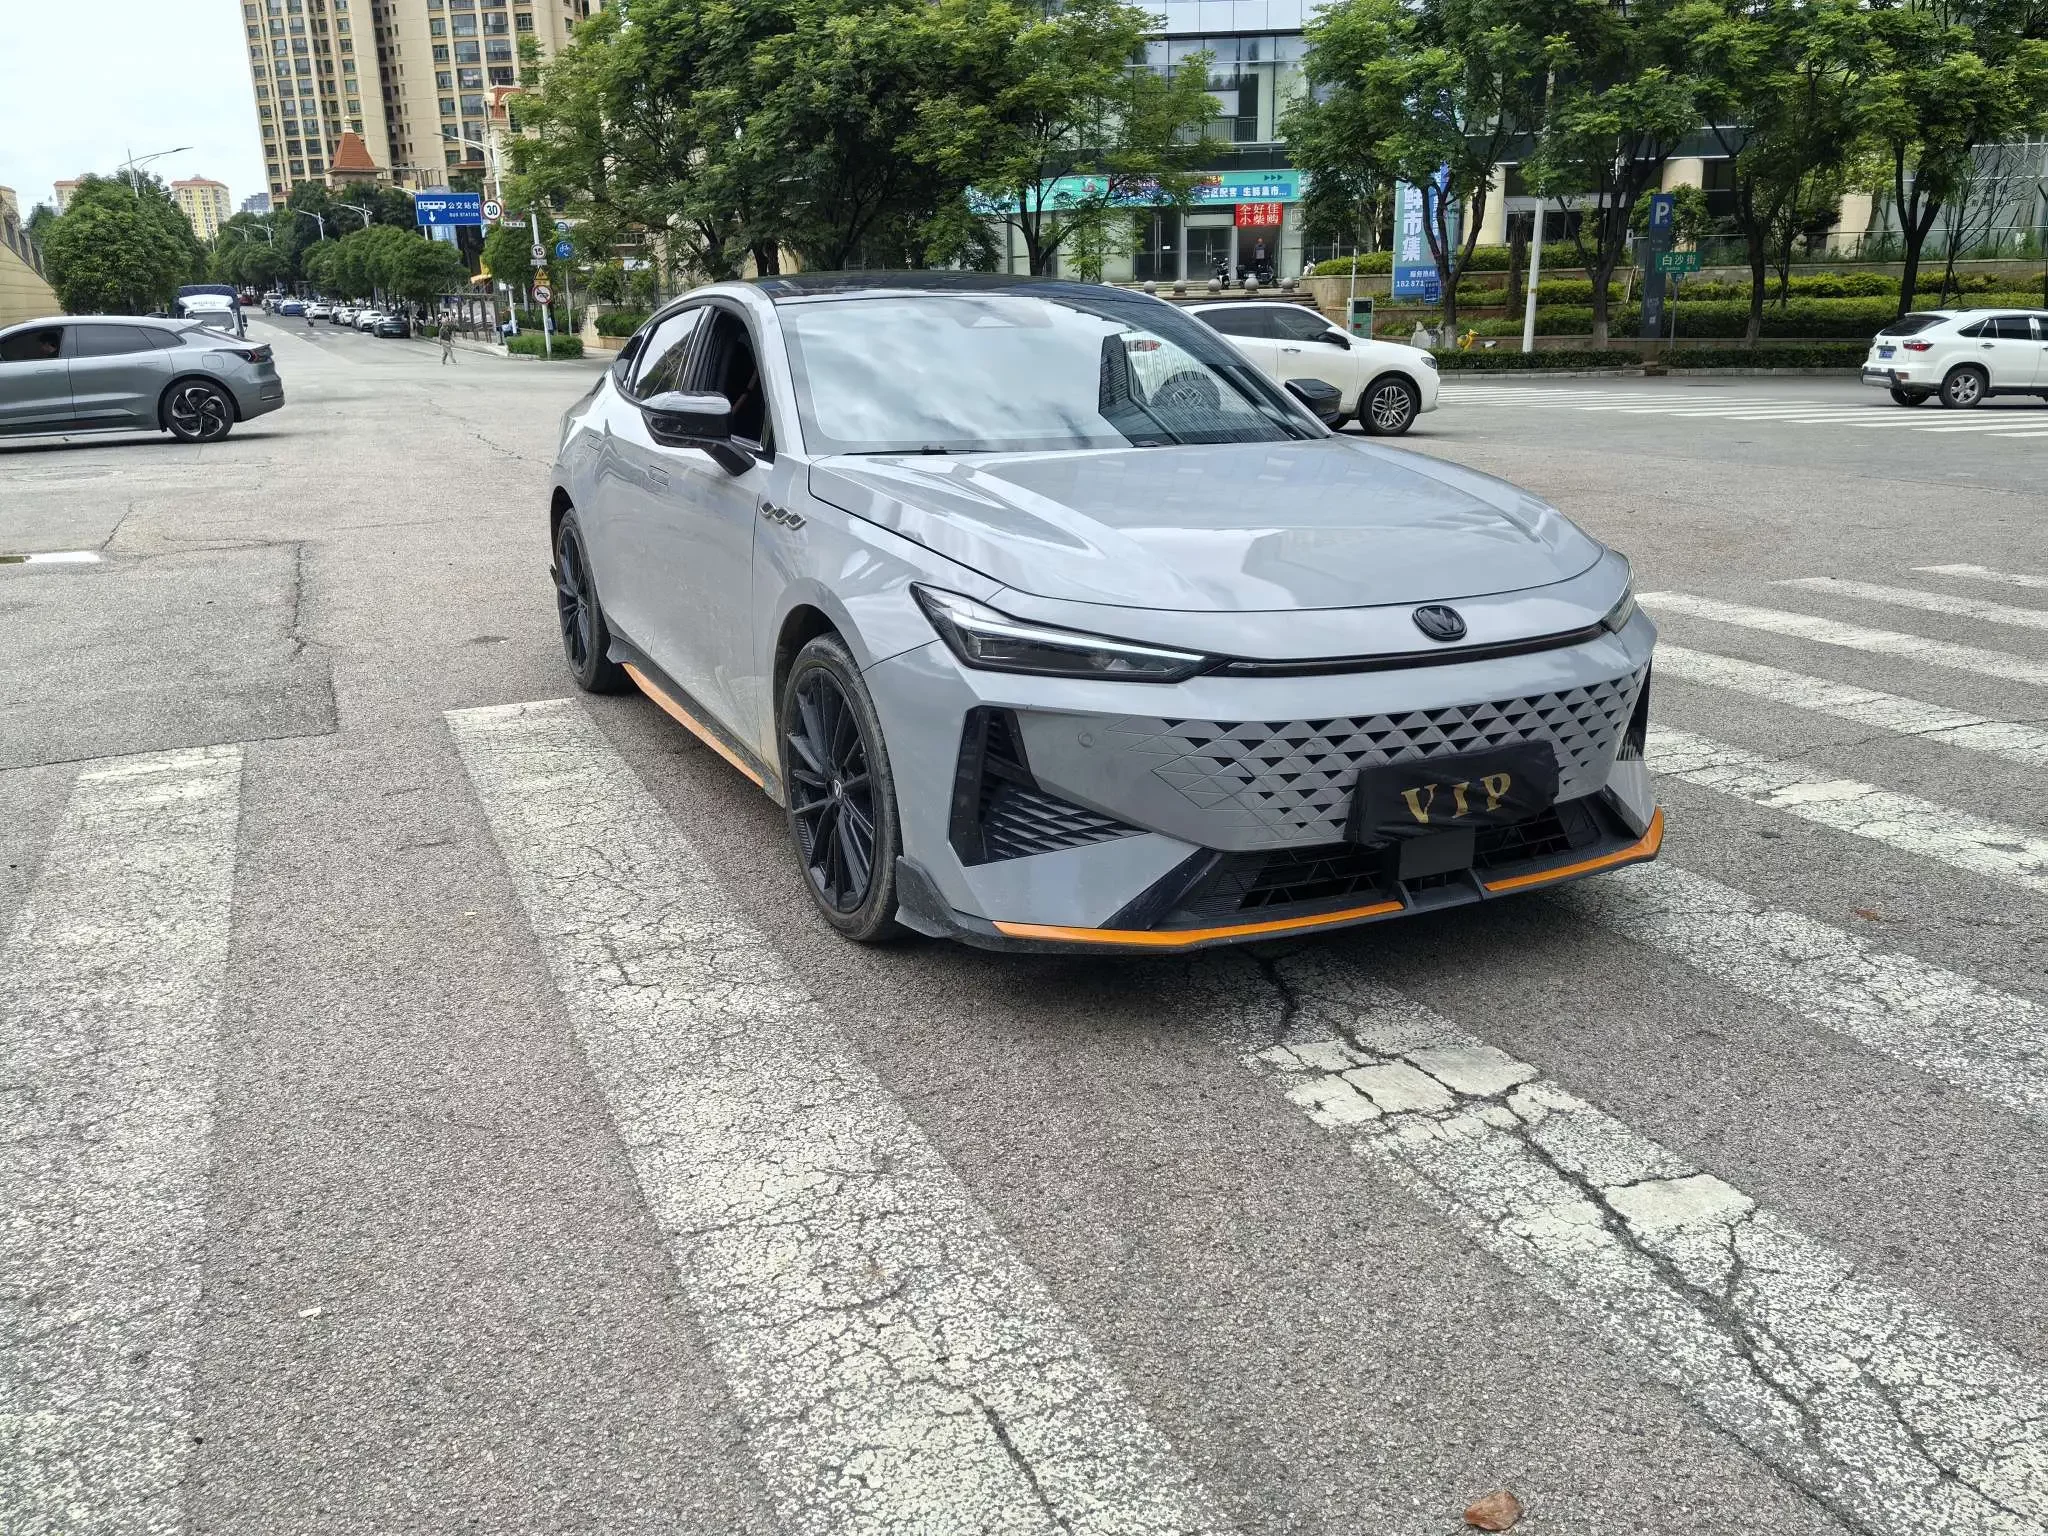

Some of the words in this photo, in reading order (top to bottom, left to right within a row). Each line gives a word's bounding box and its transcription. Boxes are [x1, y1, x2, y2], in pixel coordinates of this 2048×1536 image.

[447, 201, 480, 210] 公交站台
[486, 204, 498, 216] 30
[1655, 201, 1669, 225] P
[534, 248, 544, 256] 15
[1662, 254, 1696, 266] 白沙街
[1401, 773, 1511, 824] VIP
